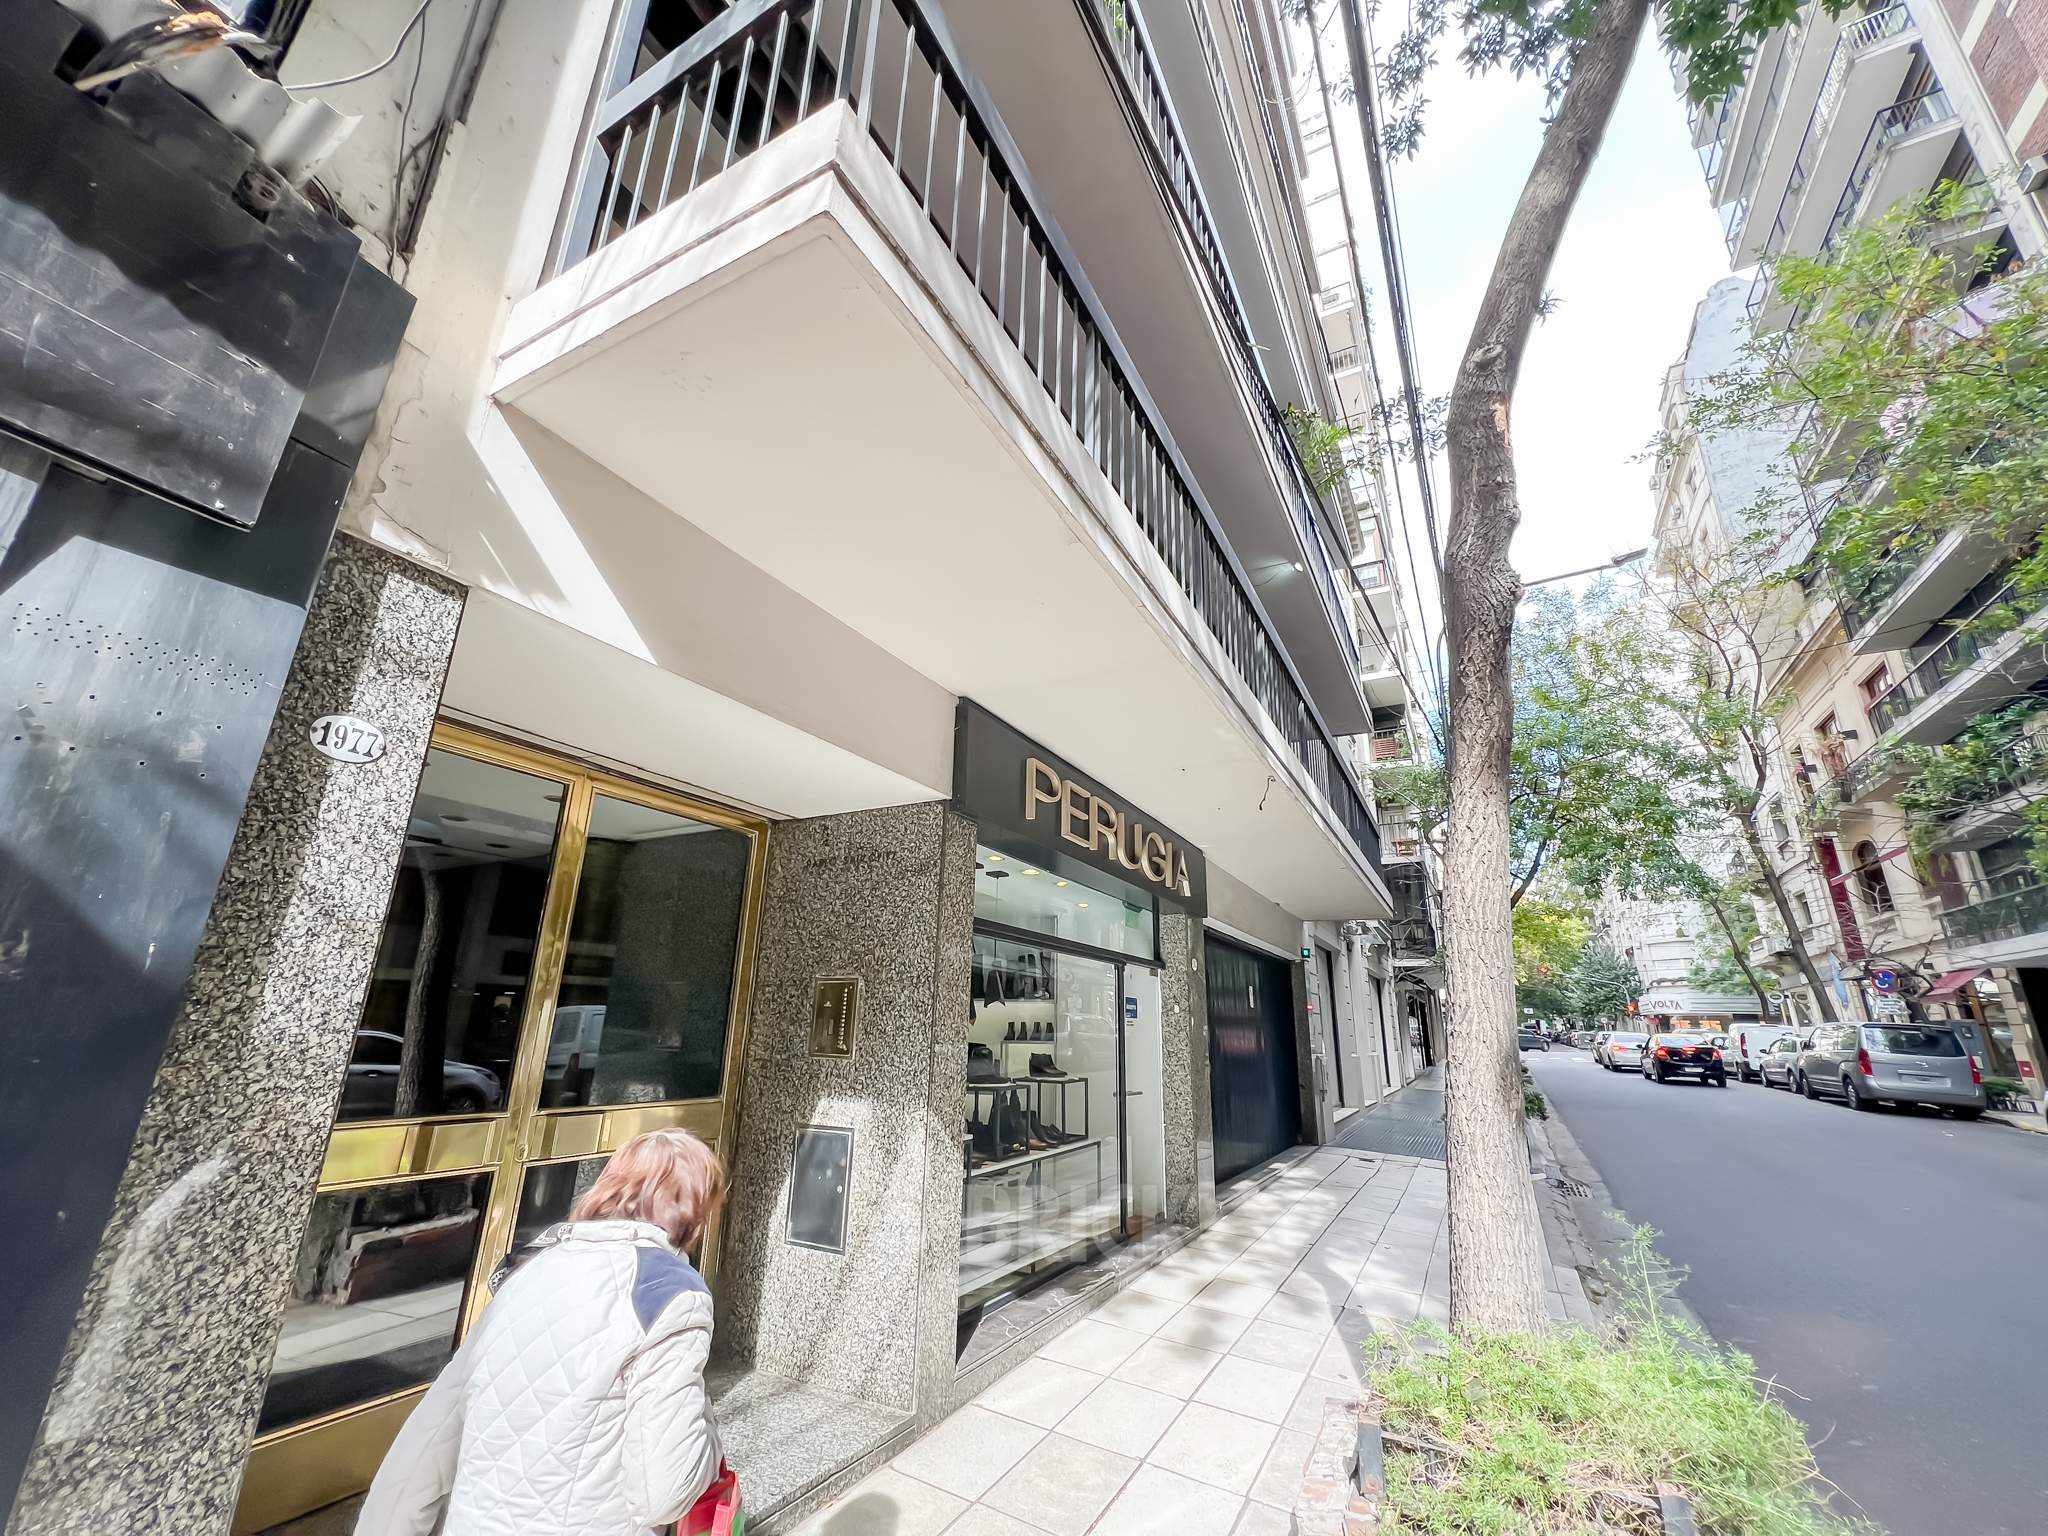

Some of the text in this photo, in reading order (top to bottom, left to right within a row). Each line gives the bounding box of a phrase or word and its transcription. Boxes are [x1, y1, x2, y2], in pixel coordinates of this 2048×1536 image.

[317, 721, 379, 758] 1977
[1025, 757, 1192, 897] PERUGIA
[1649, 1000, 1683, 1010] VOLTA
